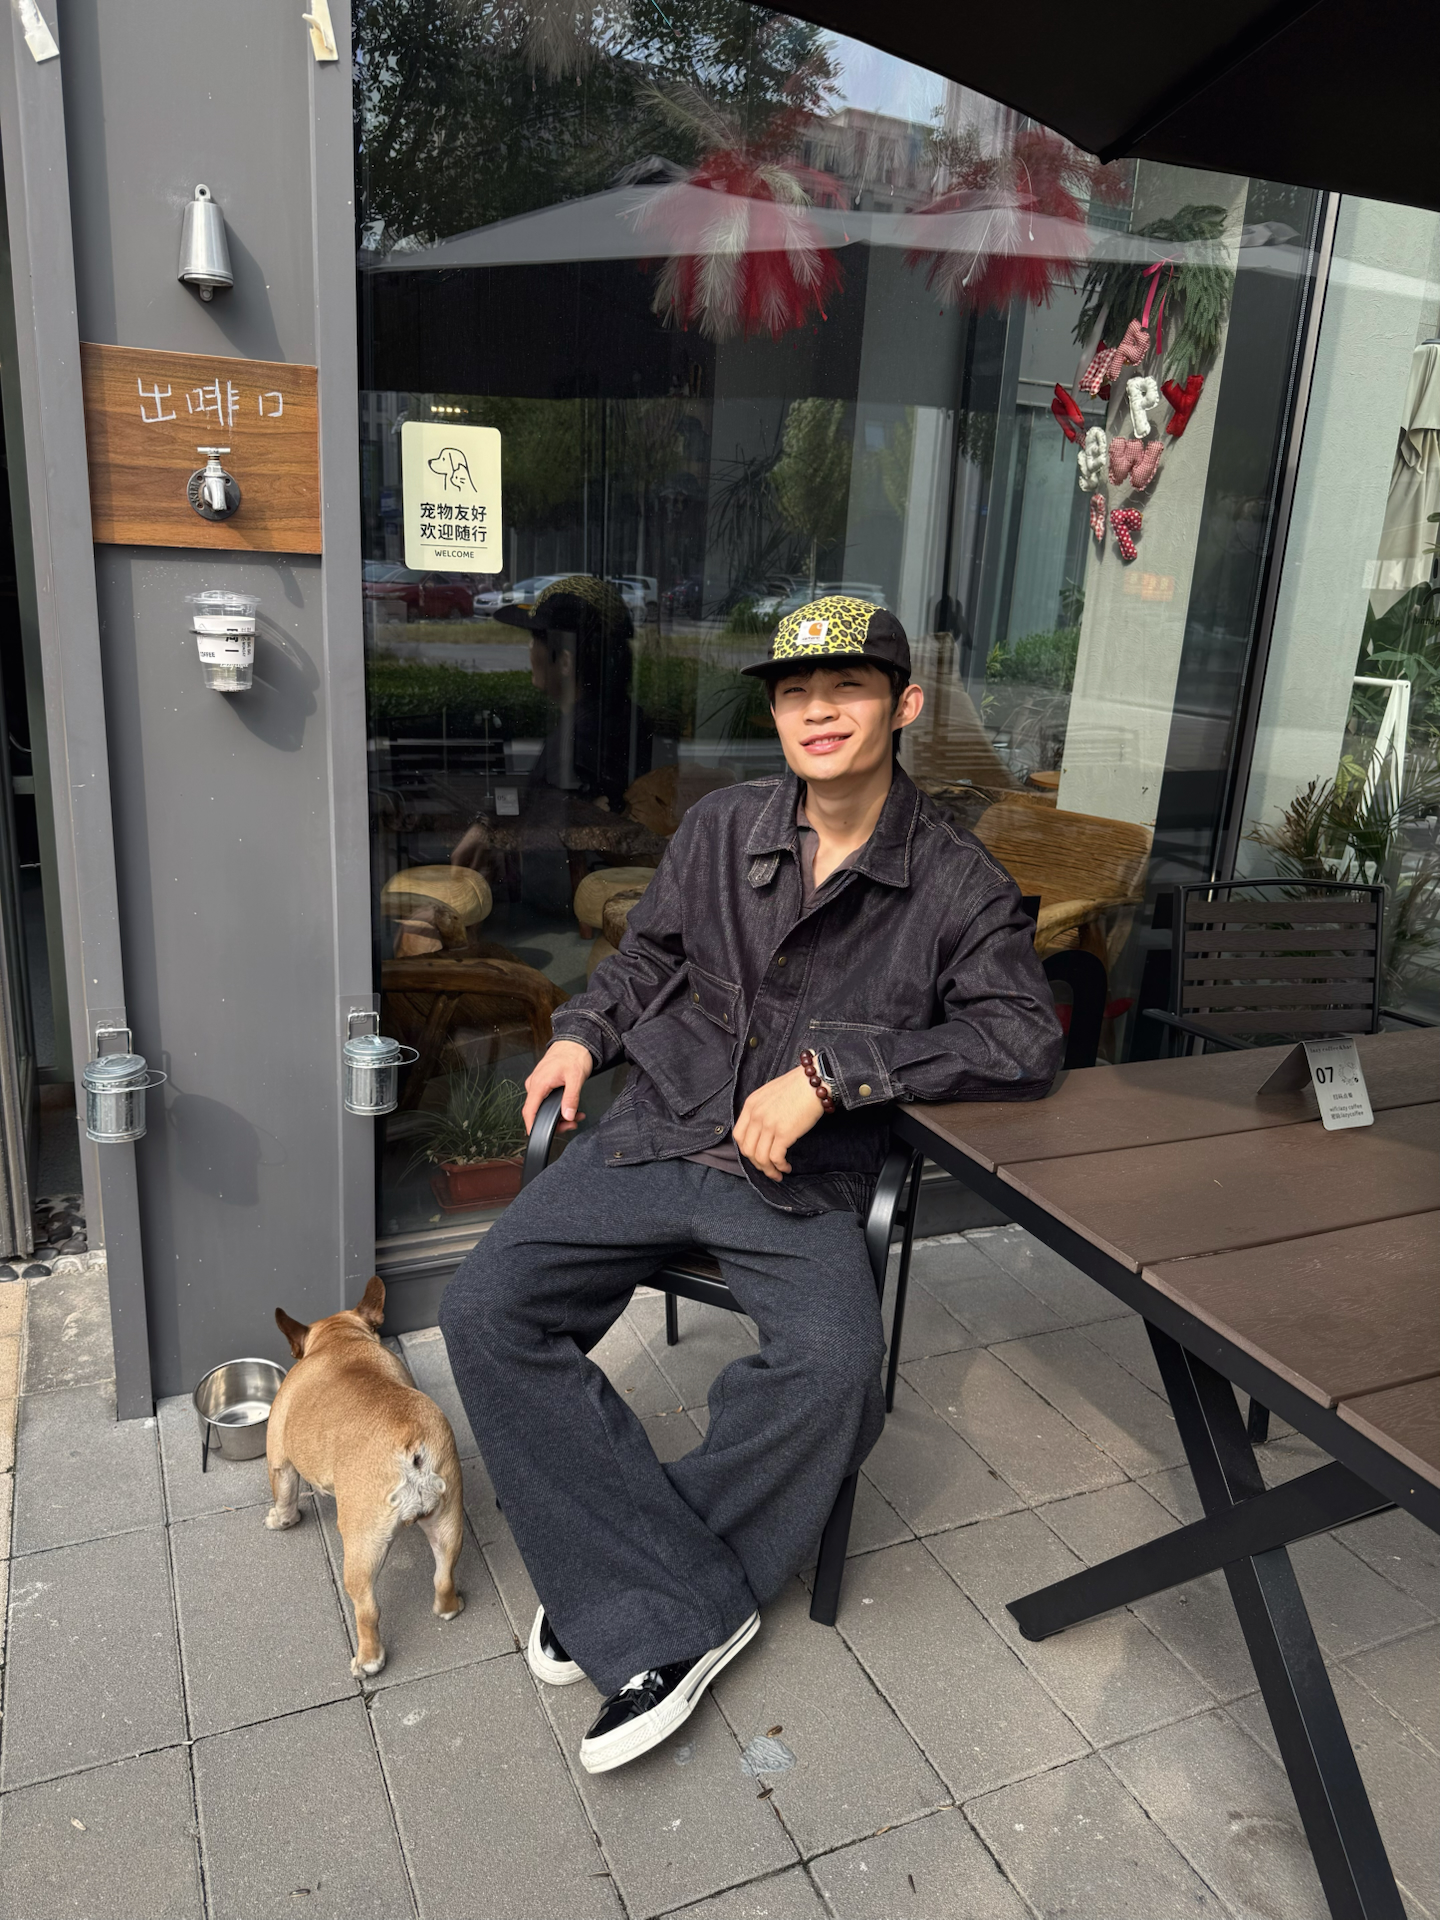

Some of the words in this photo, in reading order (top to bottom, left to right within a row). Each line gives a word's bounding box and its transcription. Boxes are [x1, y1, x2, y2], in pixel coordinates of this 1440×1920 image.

[137, 377, 284, 427] 出啡口
[420, 502, 487, 522] 宠物友好
[420, 522, 488, 542] 欢迎随行
[434, 550, 475, 559] WELCOME
[1316, 1066, 1334, 1084] 07
